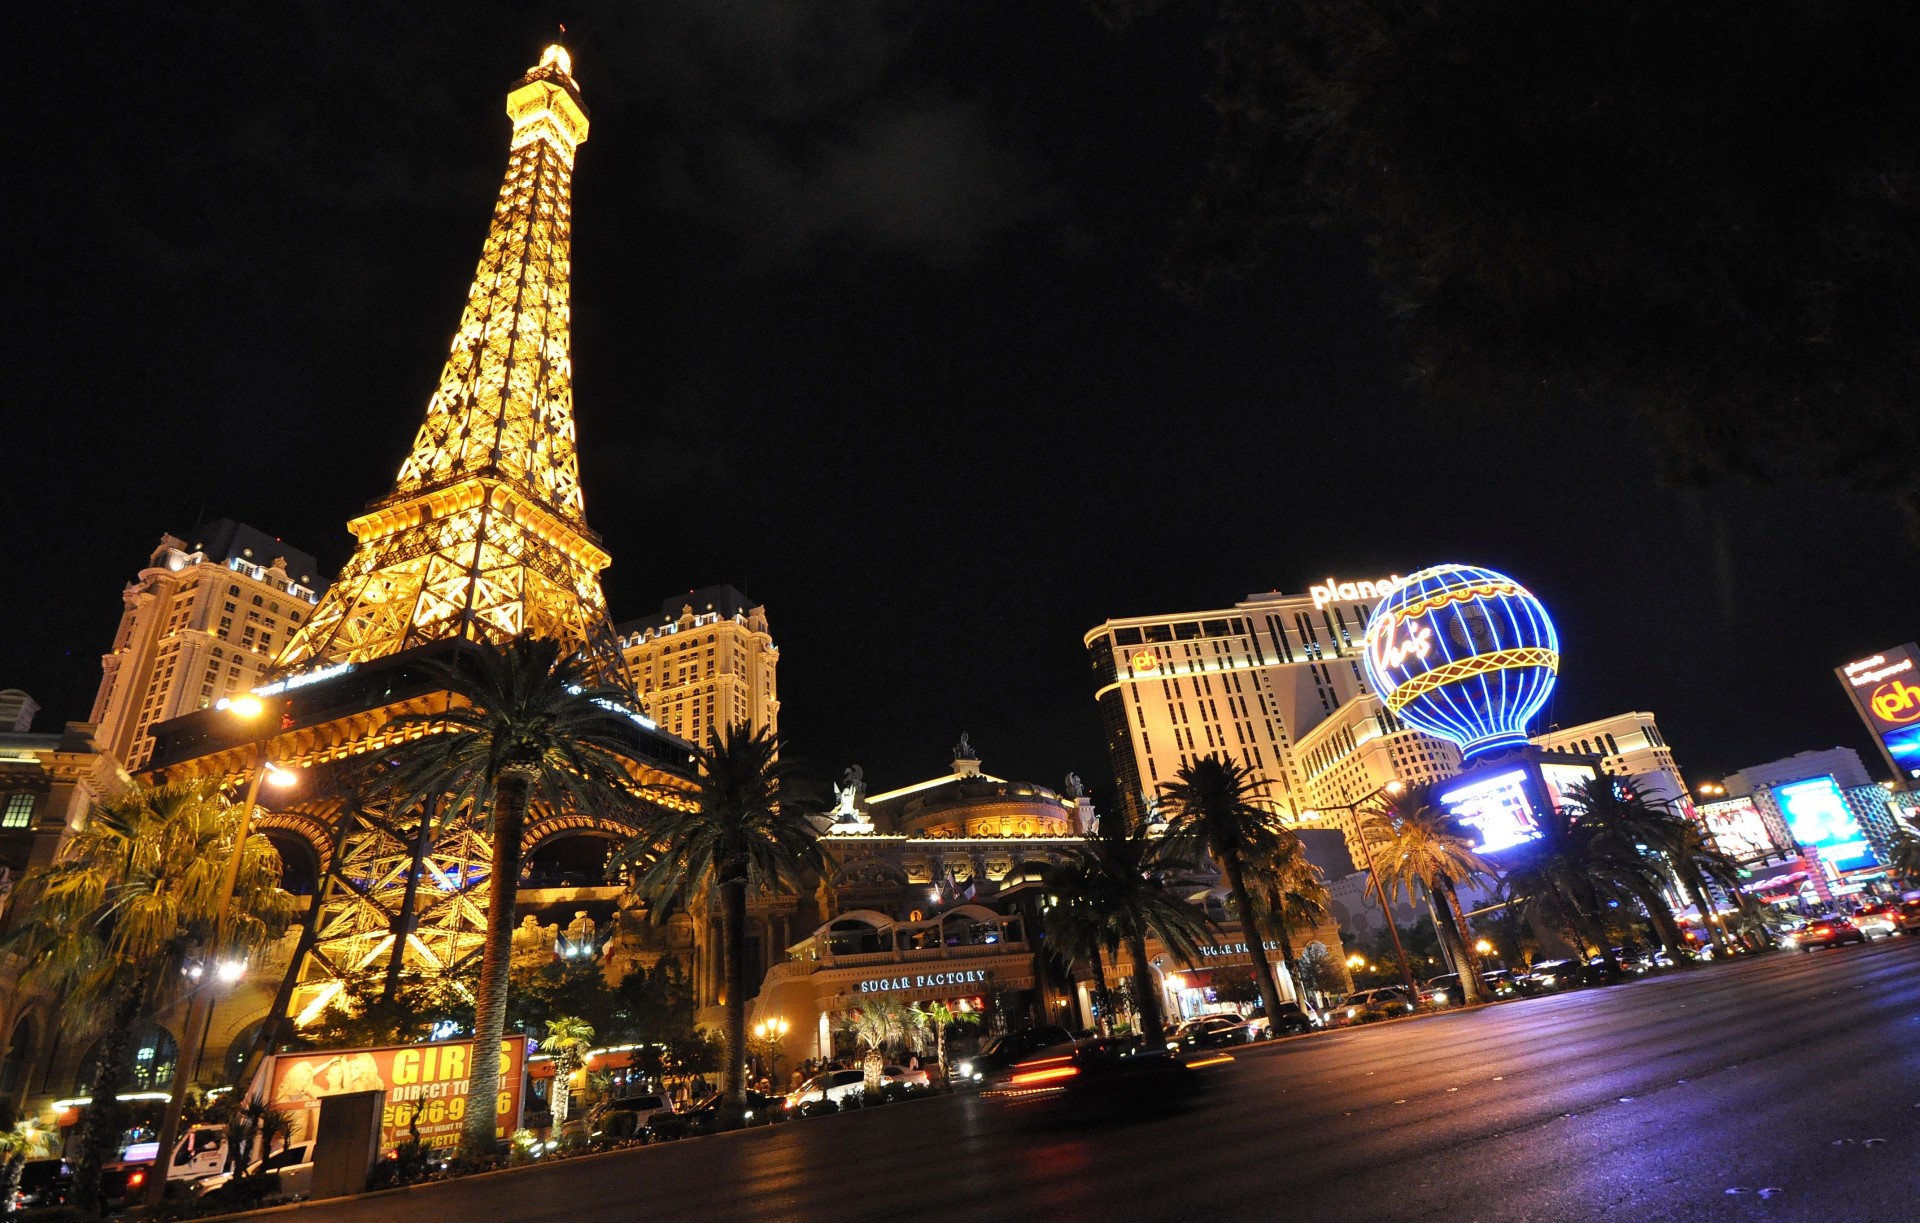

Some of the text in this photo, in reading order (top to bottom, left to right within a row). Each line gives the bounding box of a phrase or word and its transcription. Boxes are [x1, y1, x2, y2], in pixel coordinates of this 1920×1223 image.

[1310, 575, 1404, 610] planet
[1235, 940, 1280, 953] FAOR
[861, 969, 985, 993] SUGAR FACTORY
[392, 1040, 512, 1086] GIRS
[392, 1081, 450, 1102] DIRECT
[394, 1092, 512, 1127] 696-96
[434, 1123, 455, 1132] WANT
